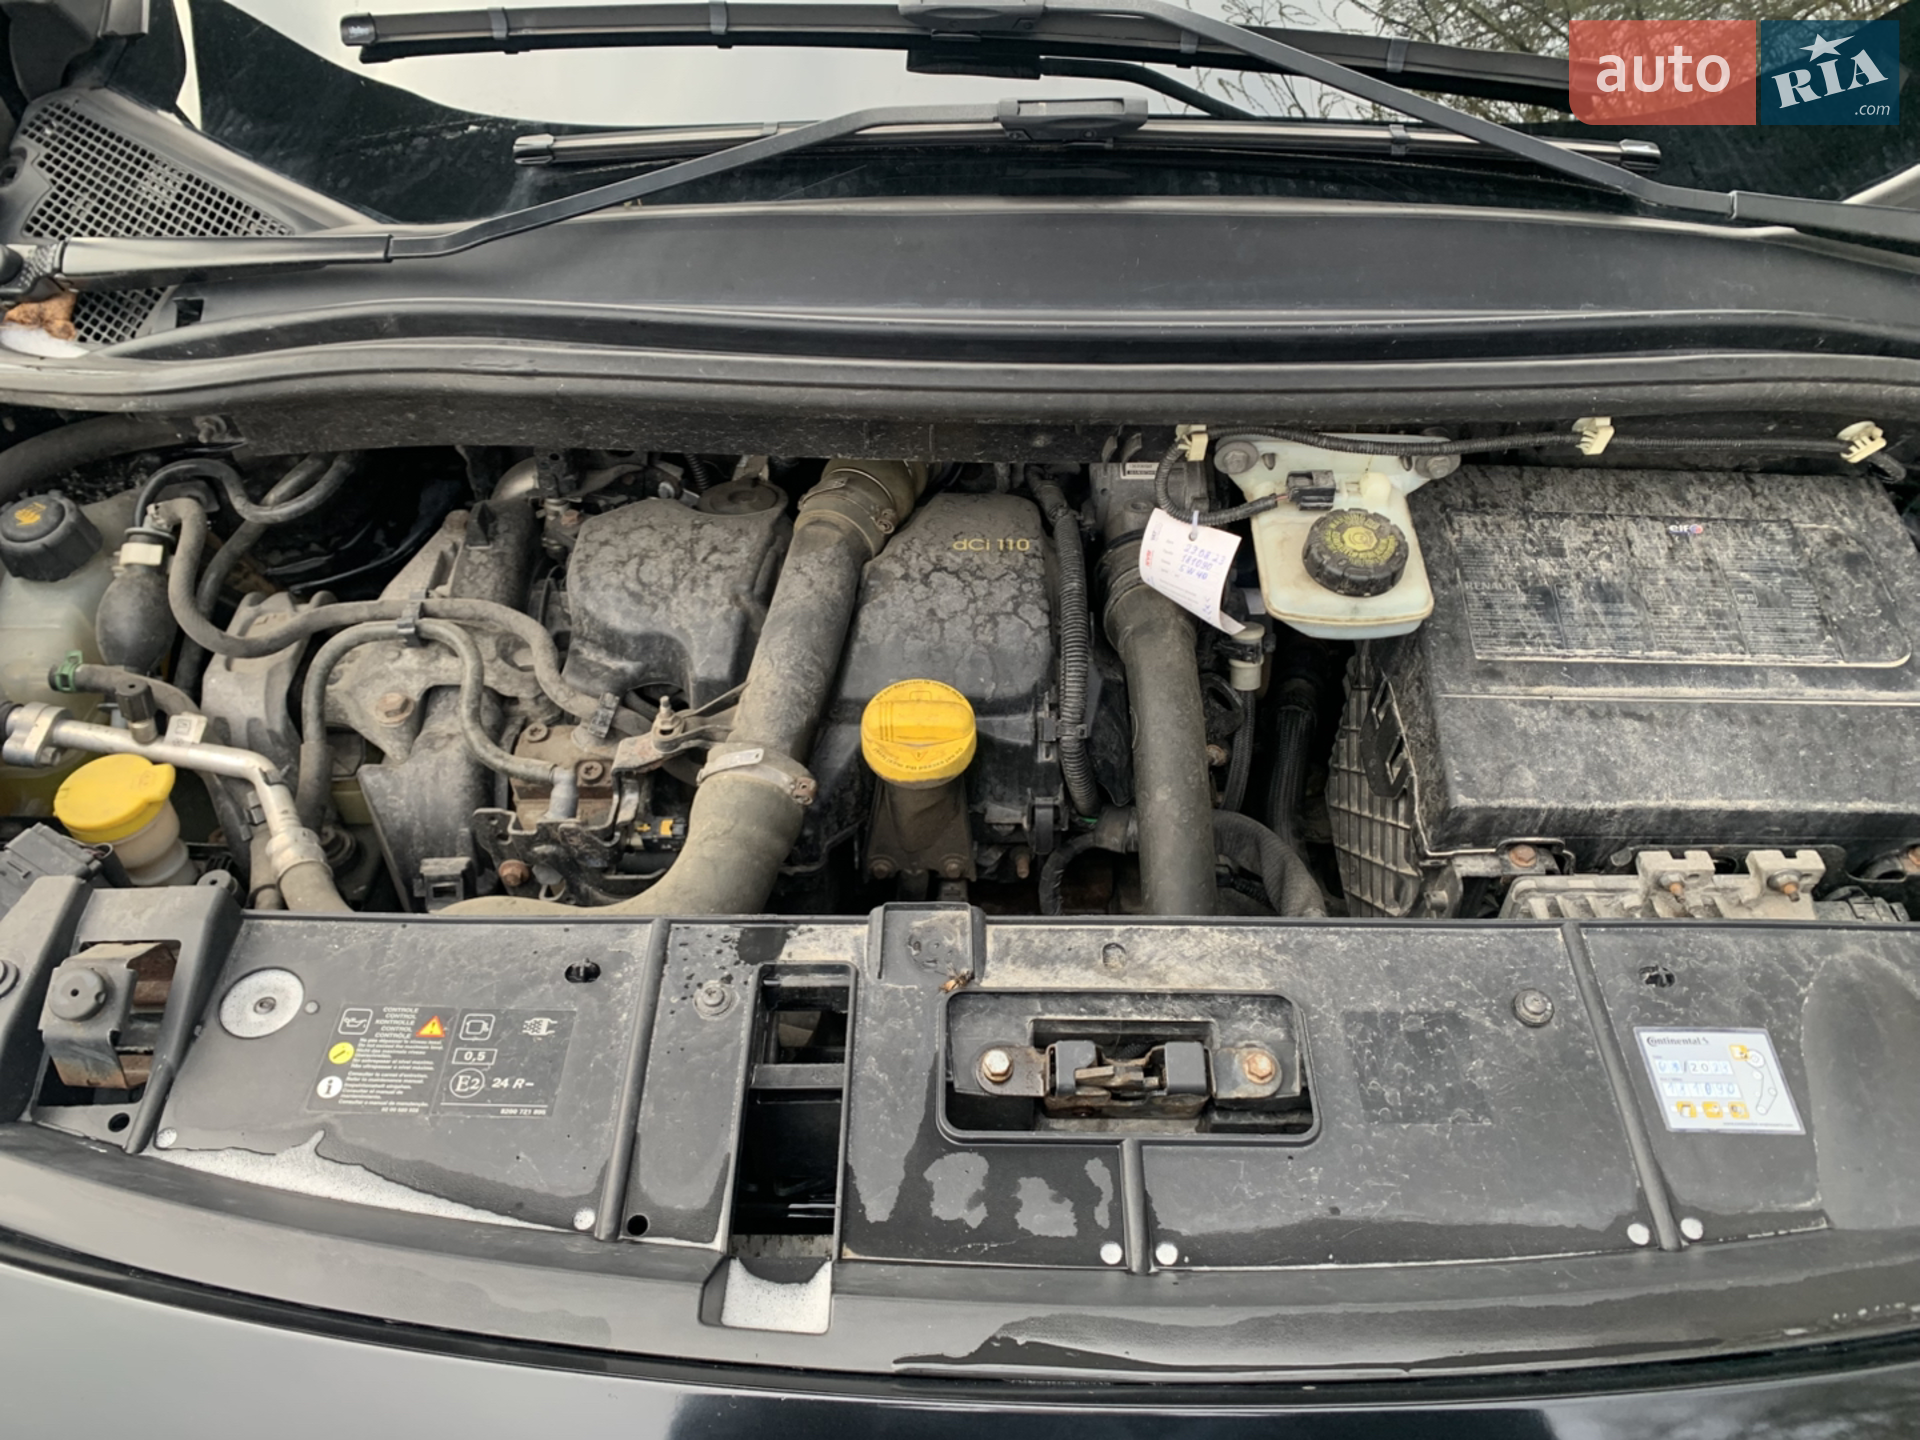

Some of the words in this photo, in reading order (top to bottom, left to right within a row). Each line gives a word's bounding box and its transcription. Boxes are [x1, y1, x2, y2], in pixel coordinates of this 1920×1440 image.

[952, 538, 990, 551] dCi
[997, 538, 1030, 551] 110
[1646, 1036, 1701, 1047] Continental
[463, 1051, 486, 1063] 0,5
[455, 1074, 480, 1092] E2
[491, 1077, 509, 1088] 24
